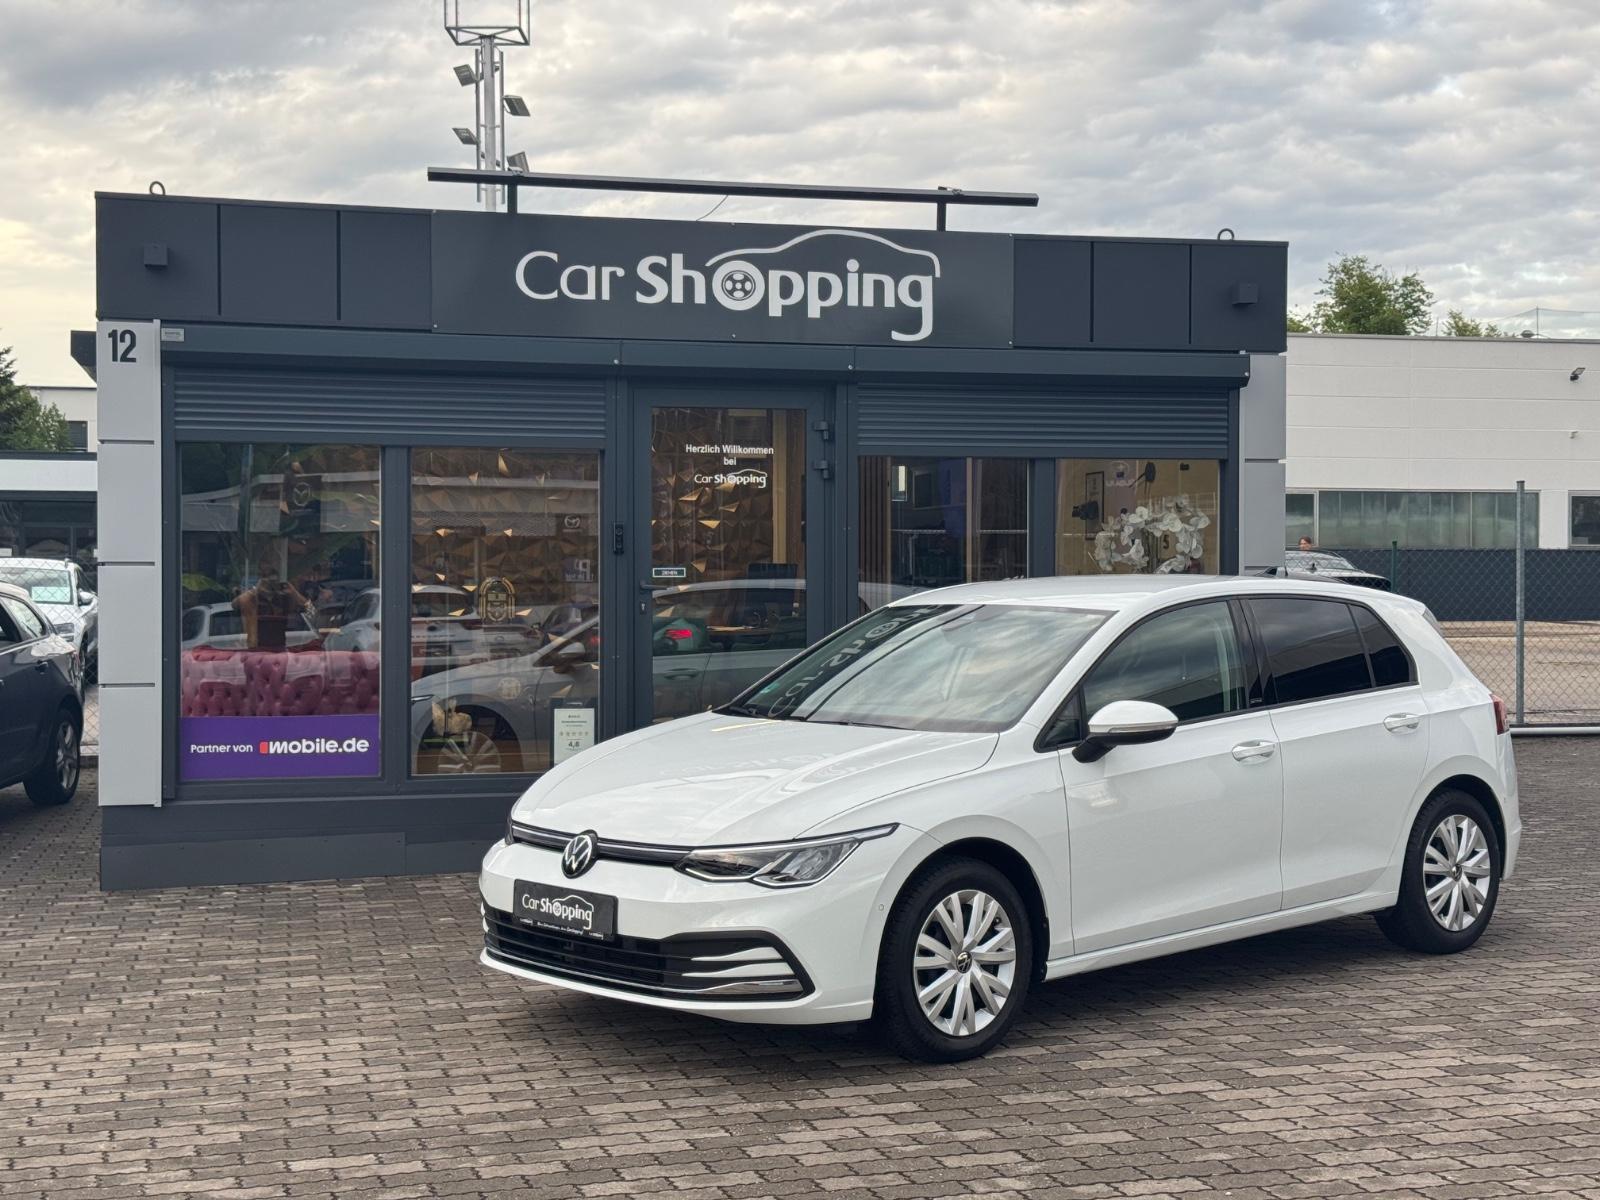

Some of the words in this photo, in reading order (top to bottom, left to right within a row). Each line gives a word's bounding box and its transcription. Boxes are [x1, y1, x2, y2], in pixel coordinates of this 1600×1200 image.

[515, 250, 625, 300] Car
[636, 253, 933, 341] Shopping
[108, 329, 136, 363] 12
[685, 444, 720, 454] Herzlich
[722, 445, 774, 454] Willkommen
[723, 457, 737, 466] bei
[694, 475, 712, 484] Car
[714, 473, 766, 489] Shopping
[190, 744, 231, 753] Partner
[233, 745, 253, 753] von
[269, 737, 370, 754] mobile.de
[522, 894, 539, 910] Car
[540, 898, 592, 930] Shopping
